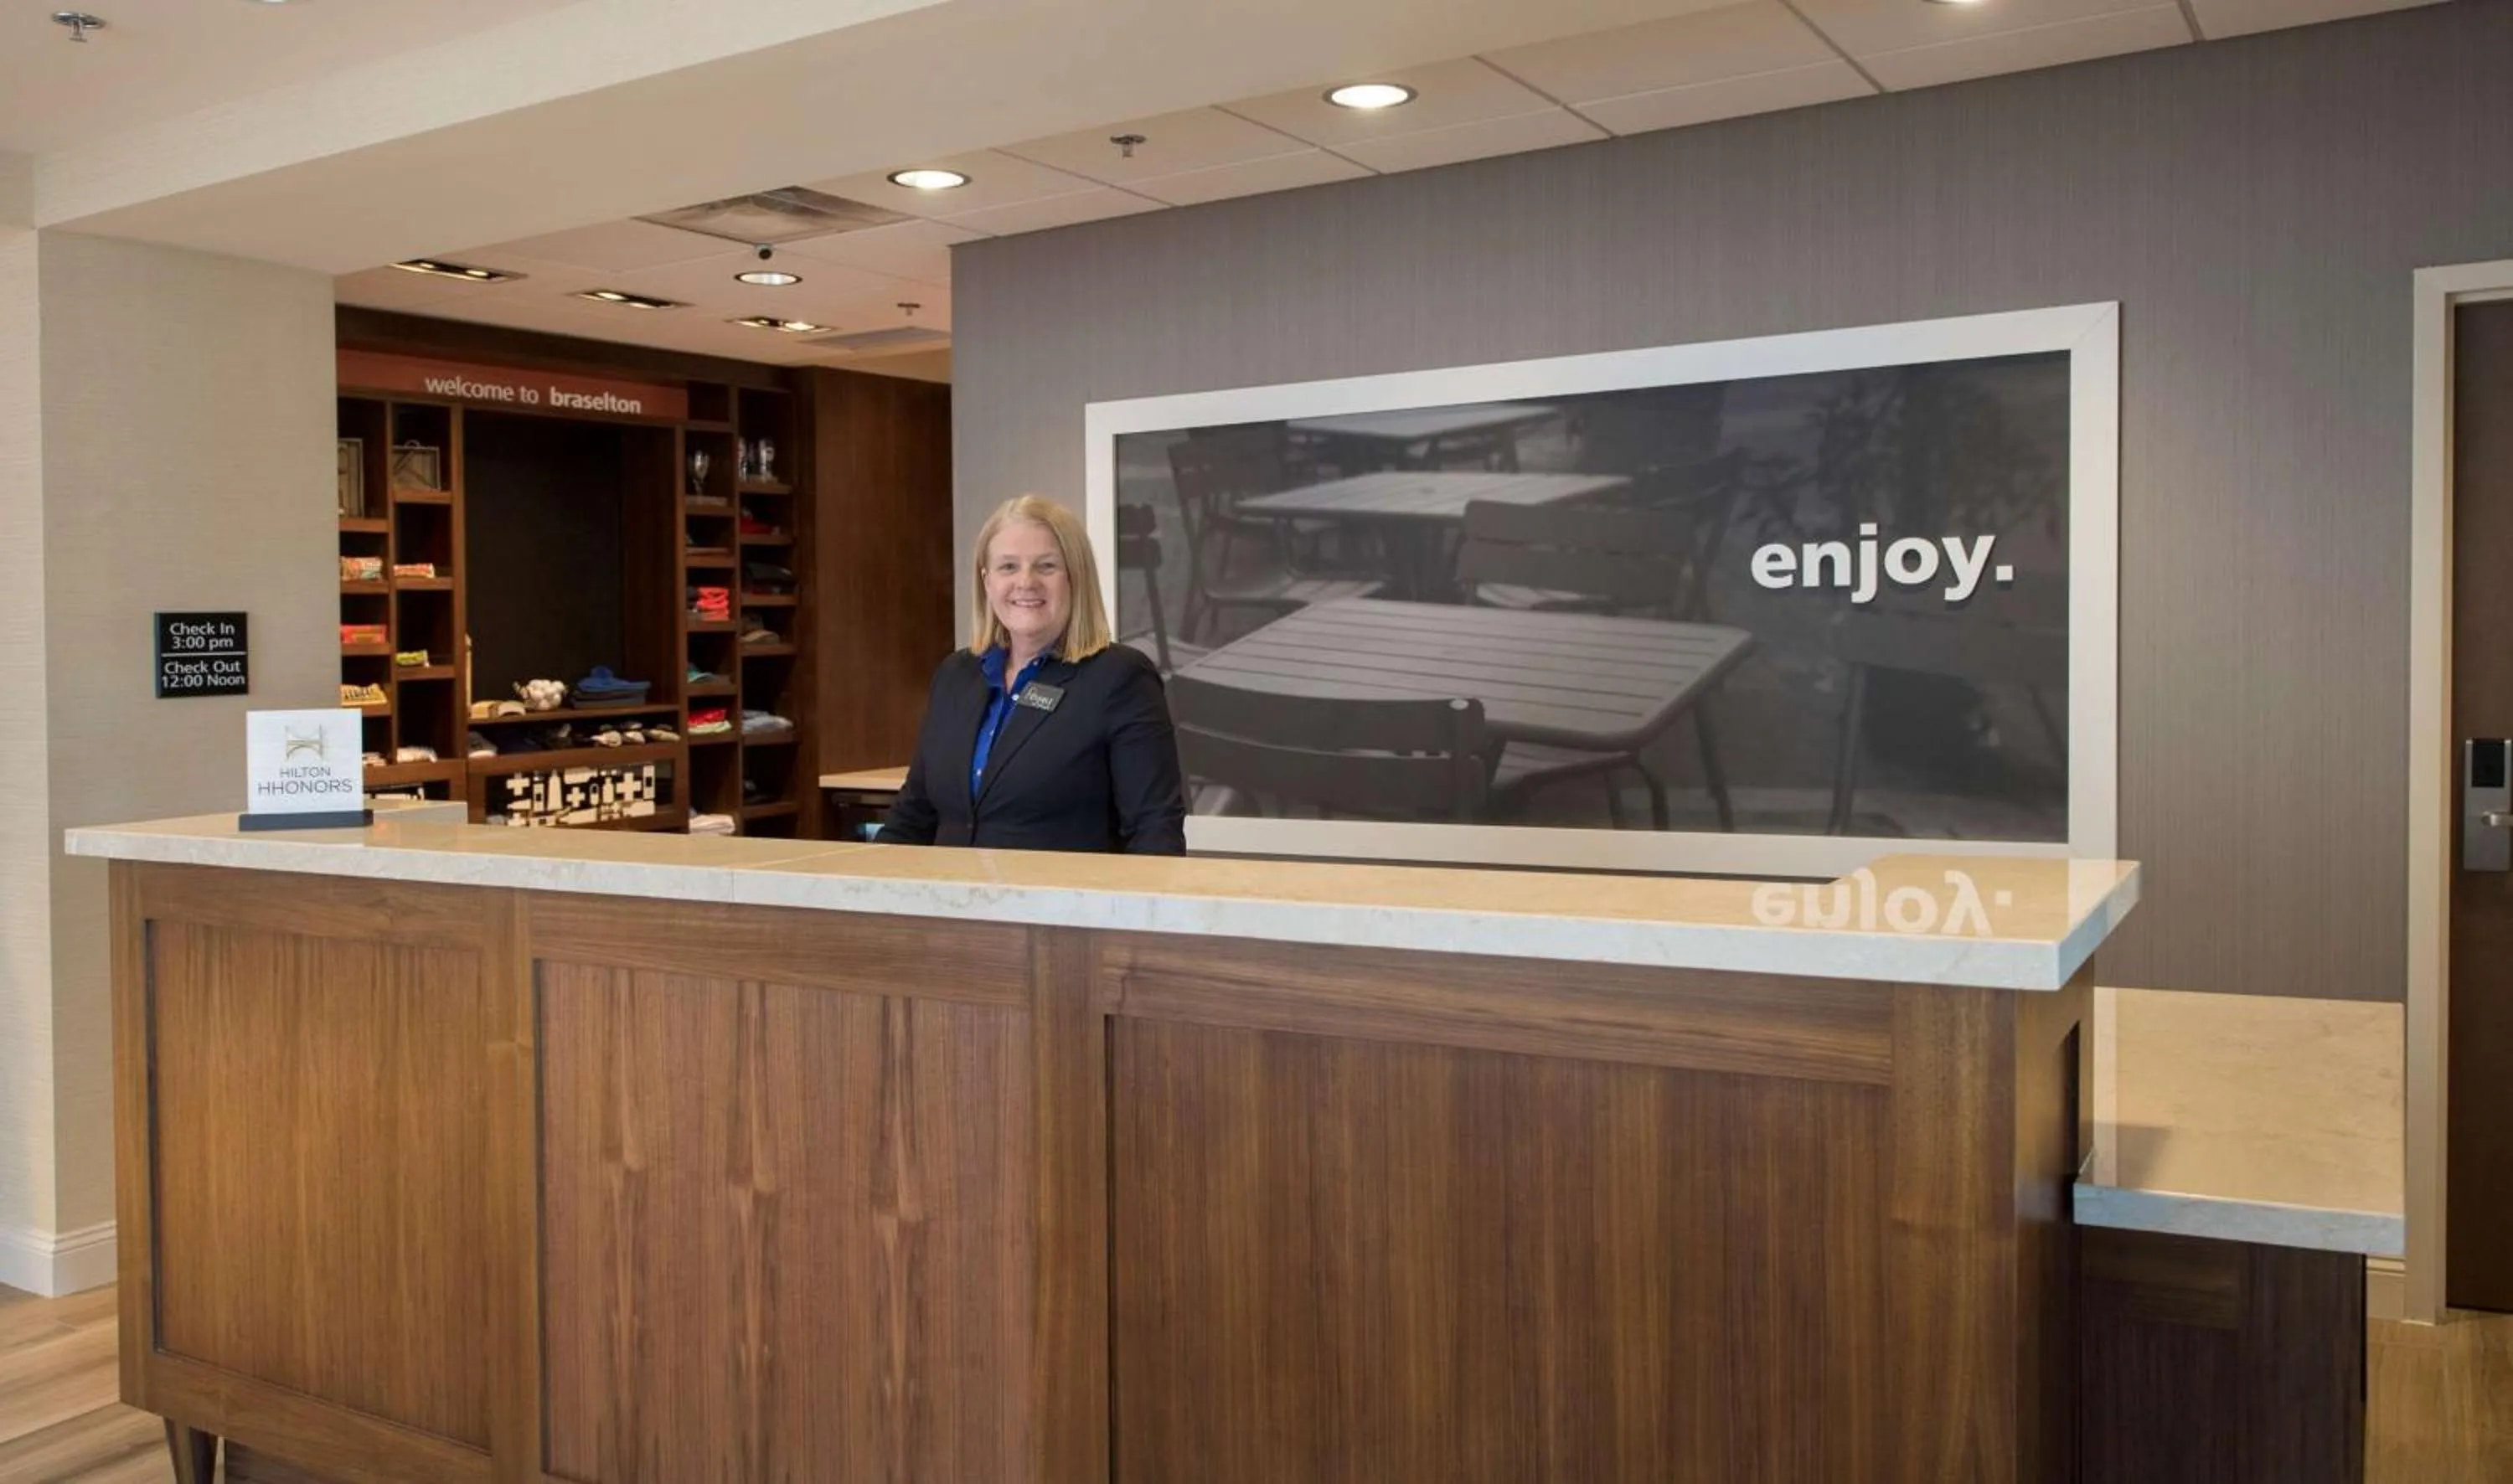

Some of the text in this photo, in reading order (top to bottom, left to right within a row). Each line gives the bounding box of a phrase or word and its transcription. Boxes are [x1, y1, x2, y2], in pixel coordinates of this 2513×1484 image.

[425, 375, 642, 415] welcome to braselton
[1750, 523, 2015, 604] enjoy.
[169, 621, 235, 636] Check In
[172, 636, 234, 651] 3:00 pm
[163, 660, 241, 674] Check Out
[162, 673, 246, 688] 12:00 Noon
[279, 766, 331, 779] HILTON
[257, 779, 353, 796] HHONORS
